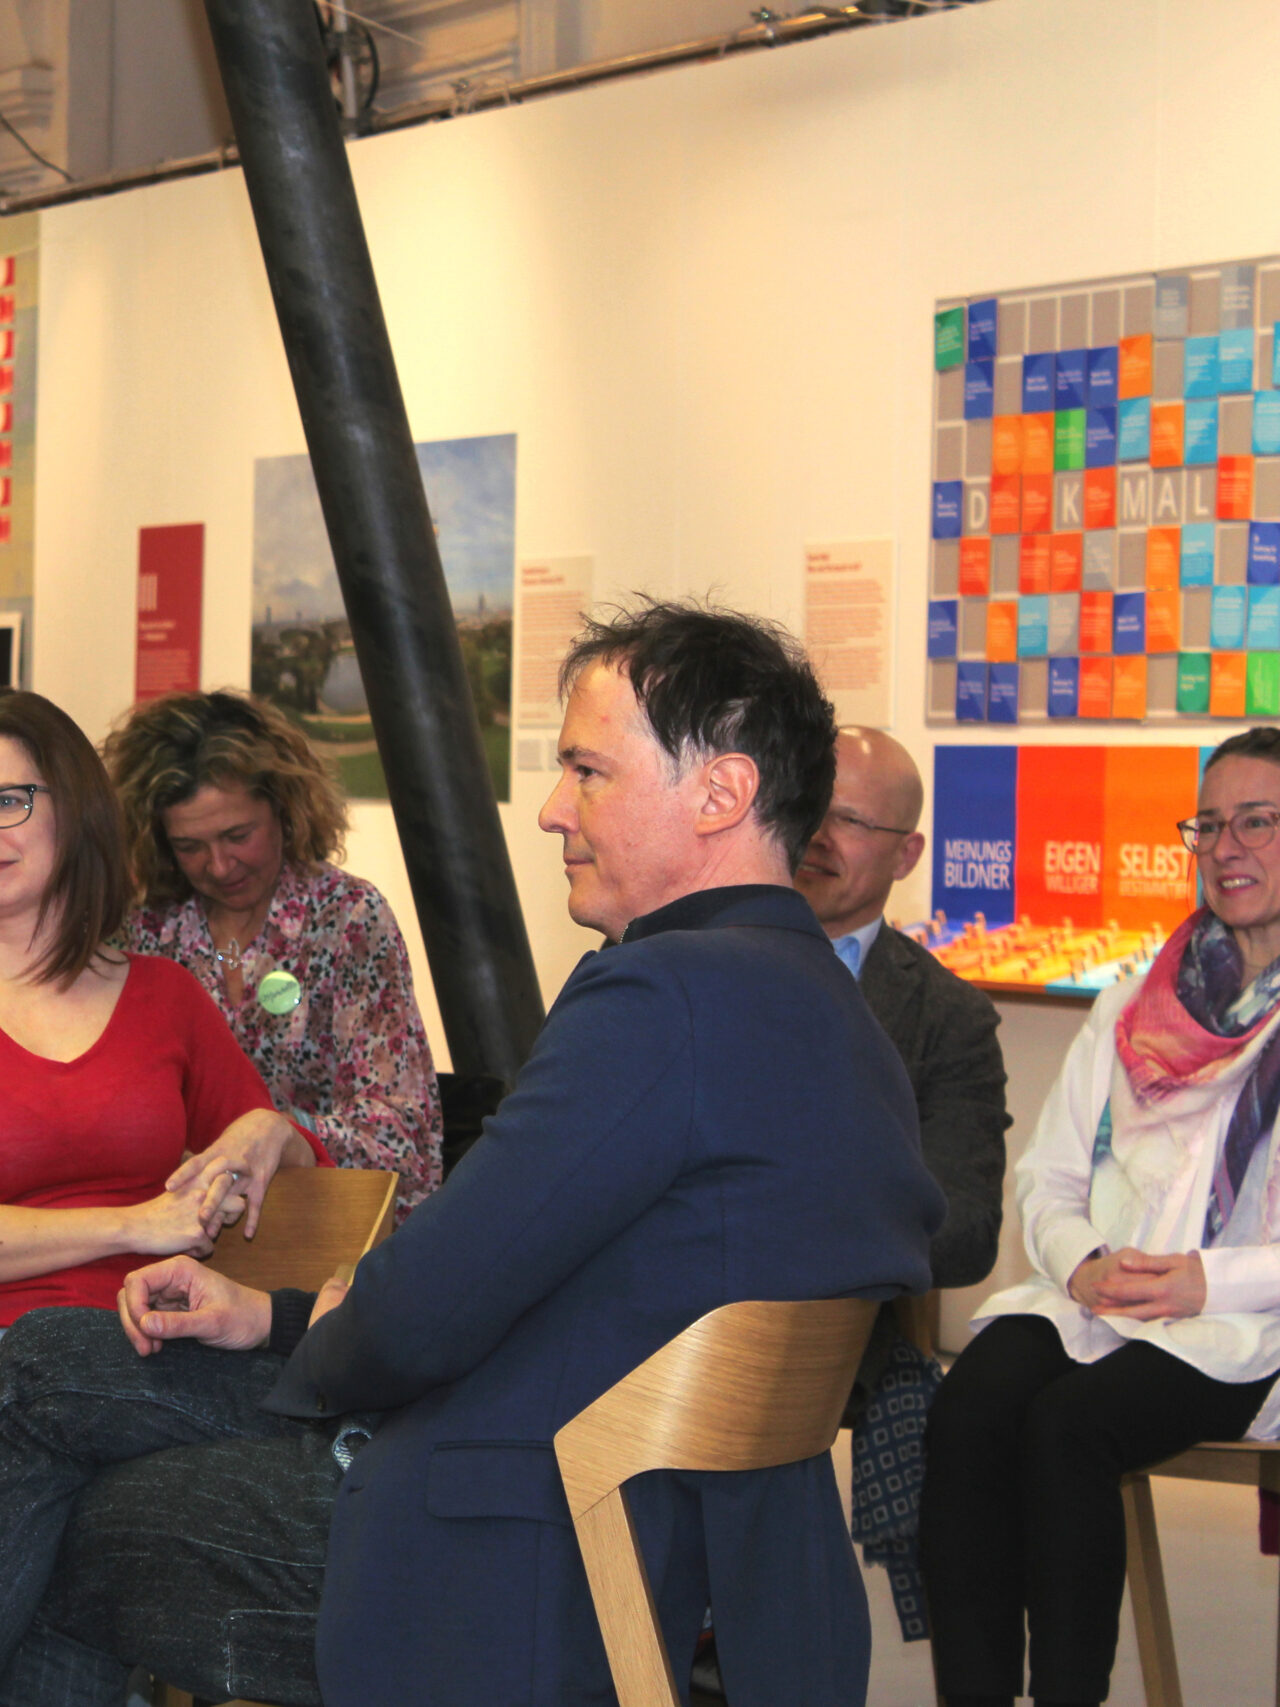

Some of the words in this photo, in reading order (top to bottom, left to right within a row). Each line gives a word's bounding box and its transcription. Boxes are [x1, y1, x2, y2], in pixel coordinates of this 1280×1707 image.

[945, 839, 1012, 862] MEINUNGS
[1045, 840, 1101, 874] EIGEN
[1119, 843, 1190, 879] SELBST
[944, 862, 1011, 889] BILDNER
